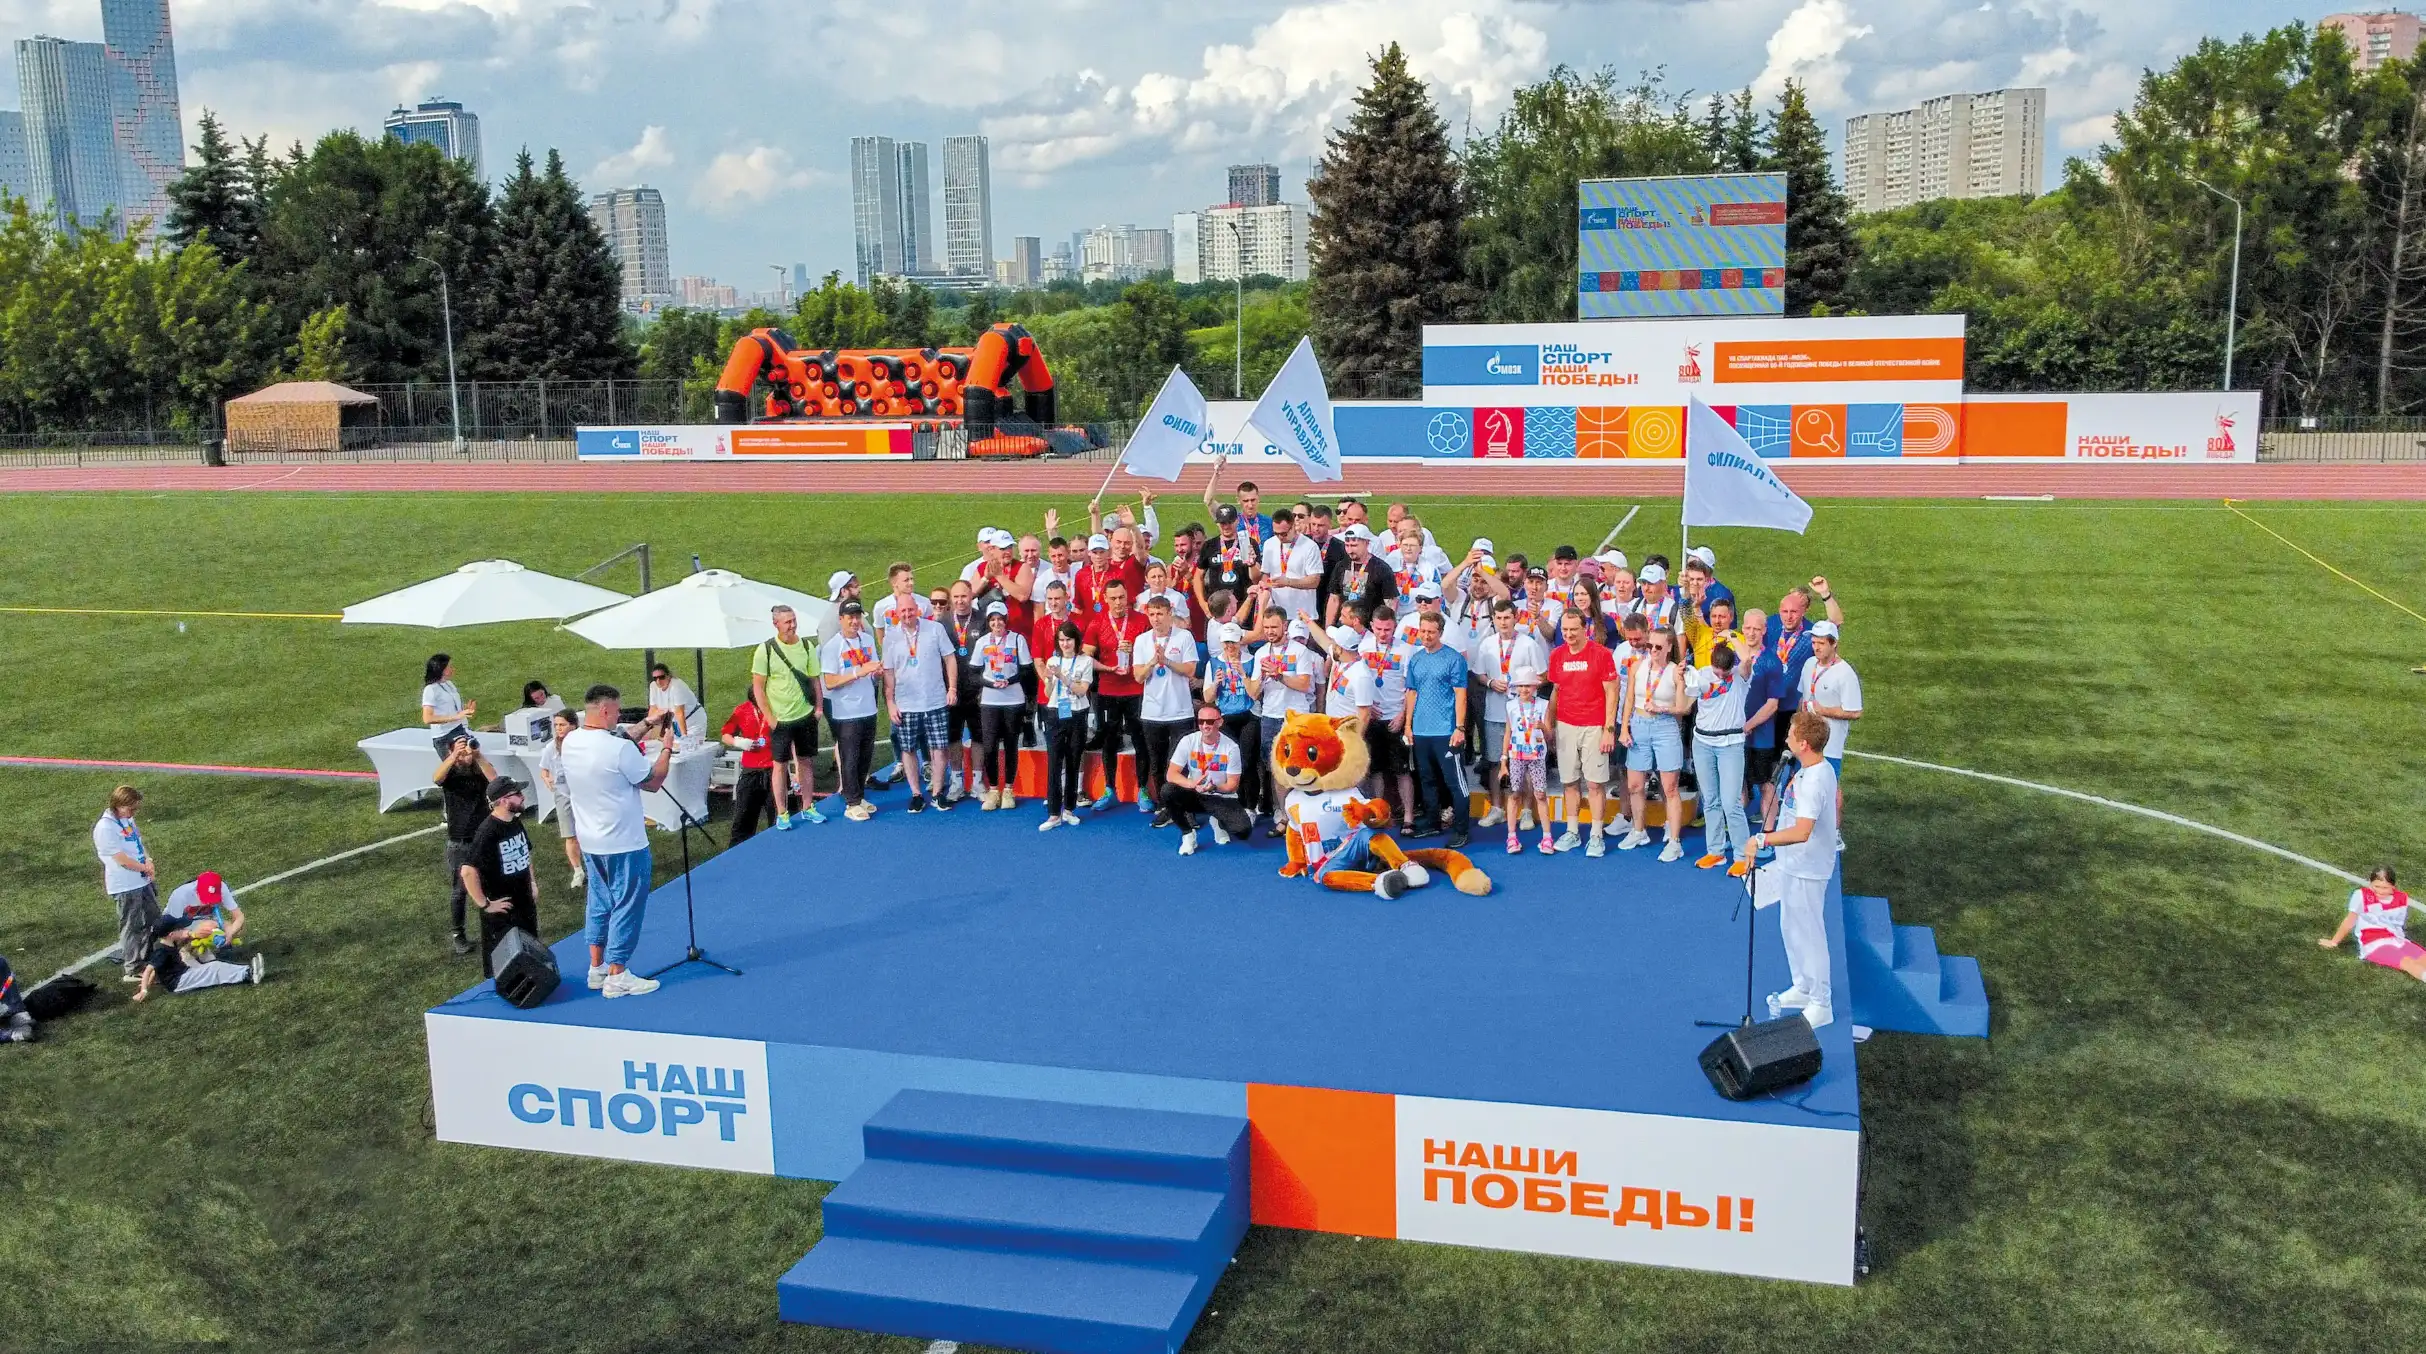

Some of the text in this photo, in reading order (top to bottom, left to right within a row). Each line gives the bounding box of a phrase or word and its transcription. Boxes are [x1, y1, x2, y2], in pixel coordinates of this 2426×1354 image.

[1618, 210, 1657, 218] СПОРТ
[1542, 344, 1577, 353] НАШ
[1542, 353, 1613, 365] СПОРТ
[1819, 360, 1842, 368] ПОБЕДЫ
[1848, 359, 1874, 367] ВЕЛИКОЙ
[1875, 359, 1921, 367] ОТЕЧЕСТВЕННОЙ
[1501, 364, 1522, 375] МОЭК
[1542, 365, 1589, 374] НАШИ
[1678, 364, 1692, 376] 80
[1542, 374, 1639, 387] ПОБЕДЫ!
[1297, 400, 1328, 453] АППАРАТ
[641, 435, 678, 443] СПОРТ
[2077, 435, 2131, 445] НАШИ
[2207, 437, 2223, 451] 80
[641, 447, 693, 456] ПОБЕДЫ!
[2077, 445, 2188, 460] ПОБЕДЫ!
[1707, 451, 1765, 480] ФИЛИАЛ
[624, 1060, 745, 1099] НАШ
[508, 1083, 747, 1142] СПОРТ
[1423, 1137, 1578, 1177] НАШИ
[1423, 1168, 1755, 1233] ПОБЕДЫ!
